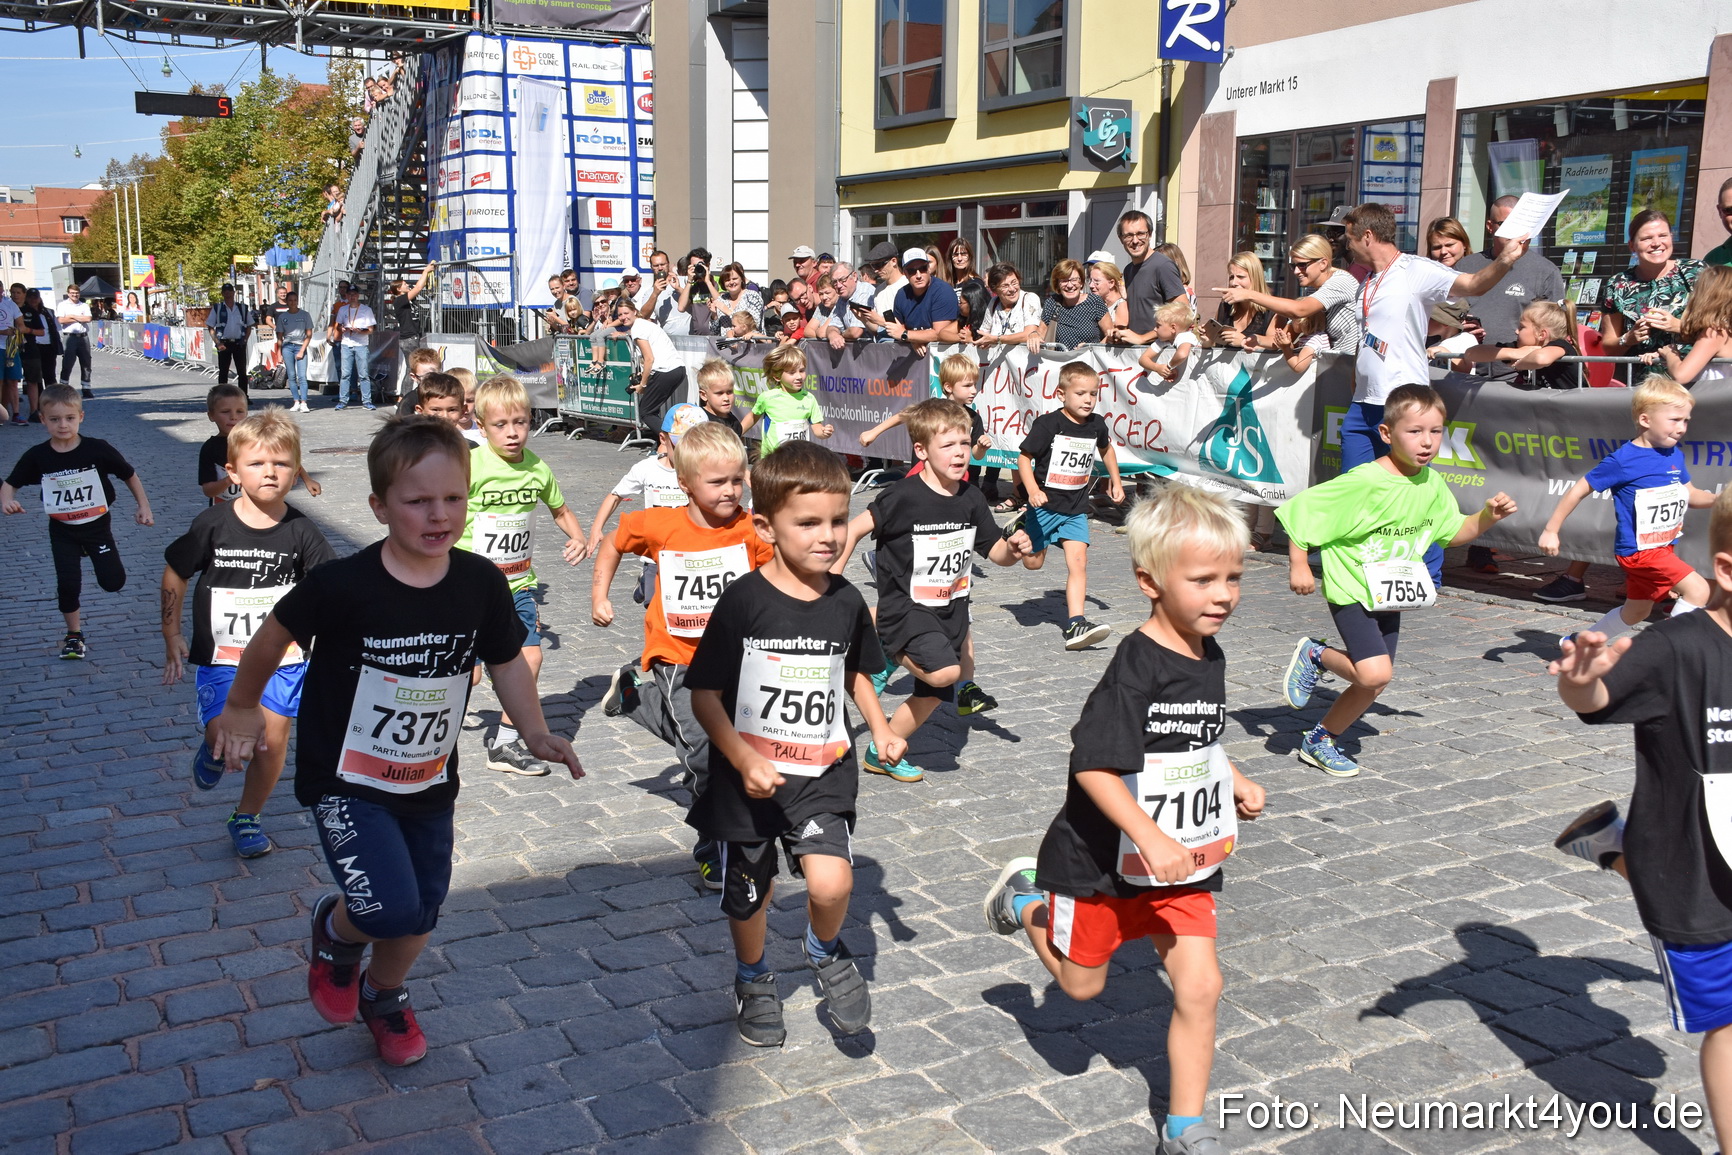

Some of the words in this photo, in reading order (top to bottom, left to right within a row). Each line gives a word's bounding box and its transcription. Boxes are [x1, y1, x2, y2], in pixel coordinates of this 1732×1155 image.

[577, 3, 612, 11] concepts
[1226, 84, 1257, 100] Unterer
[1260, 80, 1285, 95] Markt
[1287, 76, 1298, 90] 15
[218, 98, 229, 116] 5
[1565, 166, 1609, 178] Radfahren
[820, 375, 866, 395] INDUSTRY
[867, 378, 914, 398] LOUNGE
[994, 366, 1038, 398] UNS
[1494, 431, 1584, 460] OFFICE
[1060, 450, 1093, 469] 7546
[52, 484, 94, 507] 7447
[1260, 488, 1286, 500] GmbH
[67, 511, 89, 520] Lasse
[913, 521, 963, 532] Neumarkter
[485, 531, 530, 554] 7402
[214, 547, 277, 559] Neumarkter
[214, 559, 263, 571] Stadtlauf
[684, 555, 724, 569] BOCK
[1380, 580, 1428, 602] 7554
[235, 596, 275, 606] BOCK
[362, 632, 450, 649] Neumarkter
[743, 636, 828, 650] Neumarkter
[361, 649, 431, 666] Stadtlauf
[780, 665, 831, 680] BOCK
[395, 686, 448, 702] BOCK
[759, 684, 836, 727] 7566
[352, 724, 363, 734] B2
[370, 704, 452, 746] 7375
[762, 726, 789, 737] PARTL
[372, 744, 400, 758] PARTL
[401, 751, 433, 759] Neumarkt
[381, 764, 425, 781] Julian
[1164, 760, 1210, 781] BOCK
[1144, 780, 1222, 830] 7104
[801, 828, 824, 840] adidas
[1180, 831, 1213, 844] Neumarkt
[318, 950, 333, 961] FILA
